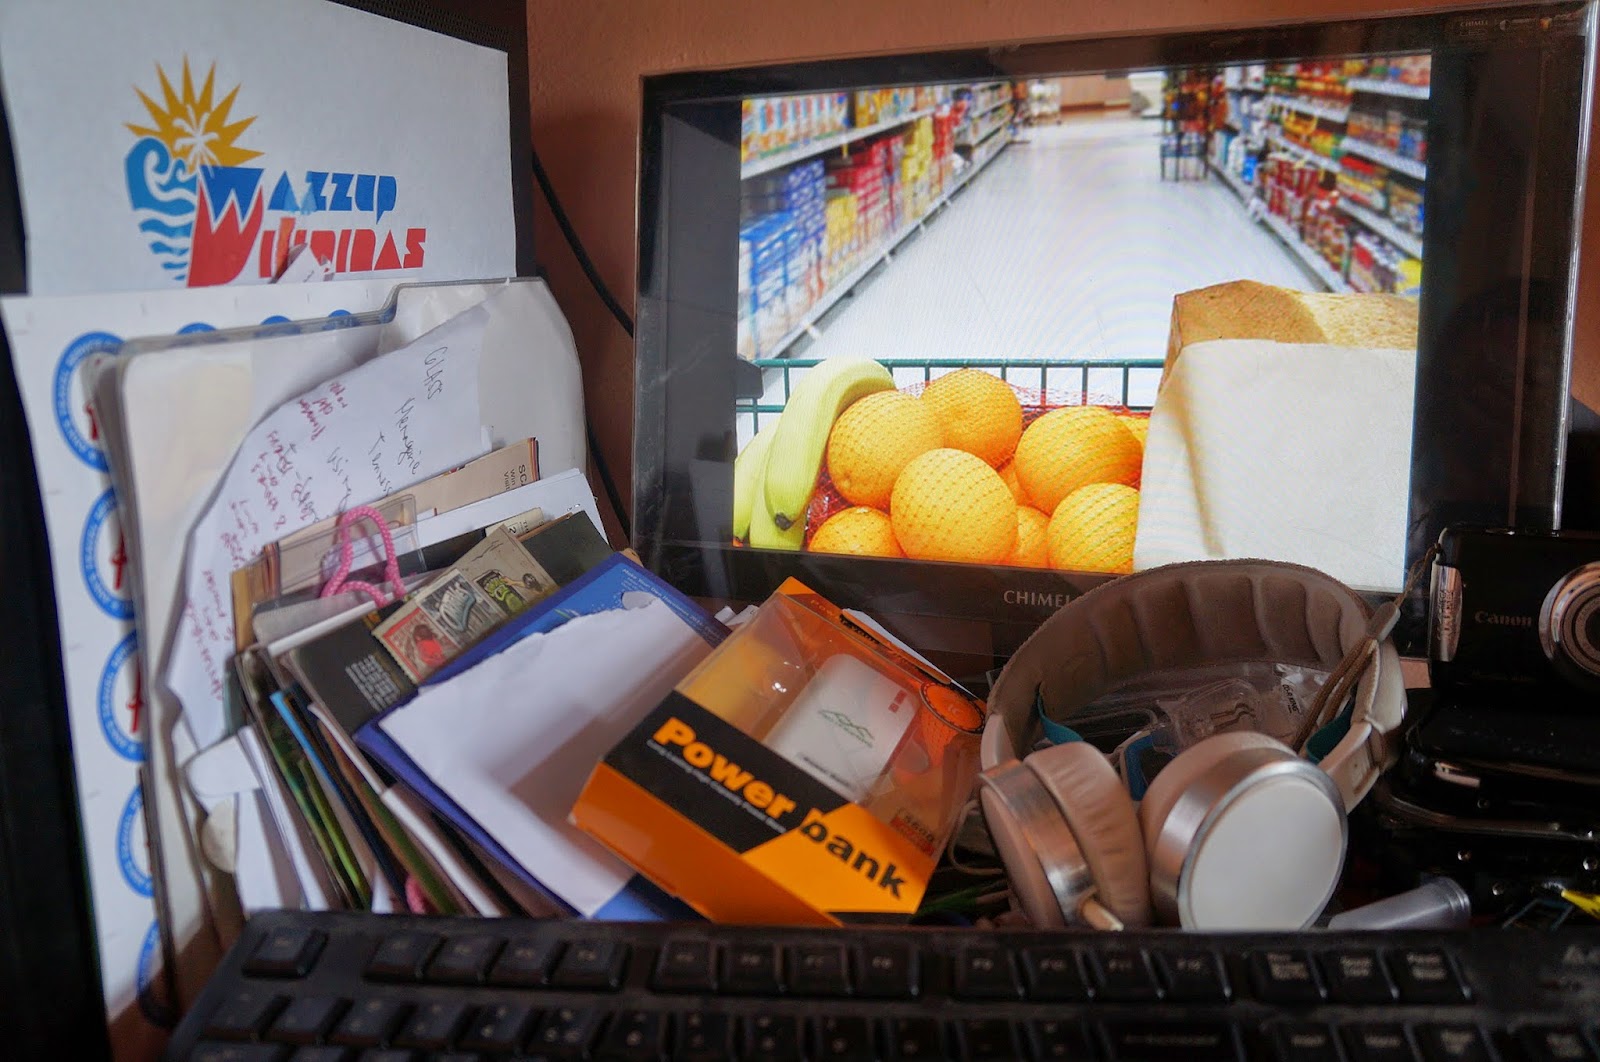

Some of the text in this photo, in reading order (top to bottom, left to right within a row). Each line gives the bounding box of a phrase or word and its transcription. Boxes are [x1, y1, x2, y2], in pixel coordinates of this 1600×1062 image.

[518, 464, 527, 487] SC
[1473, 610, 1532, 627] Canon
[652, 717, 797, 820] Power
[800, 808, 907, 900] bank
